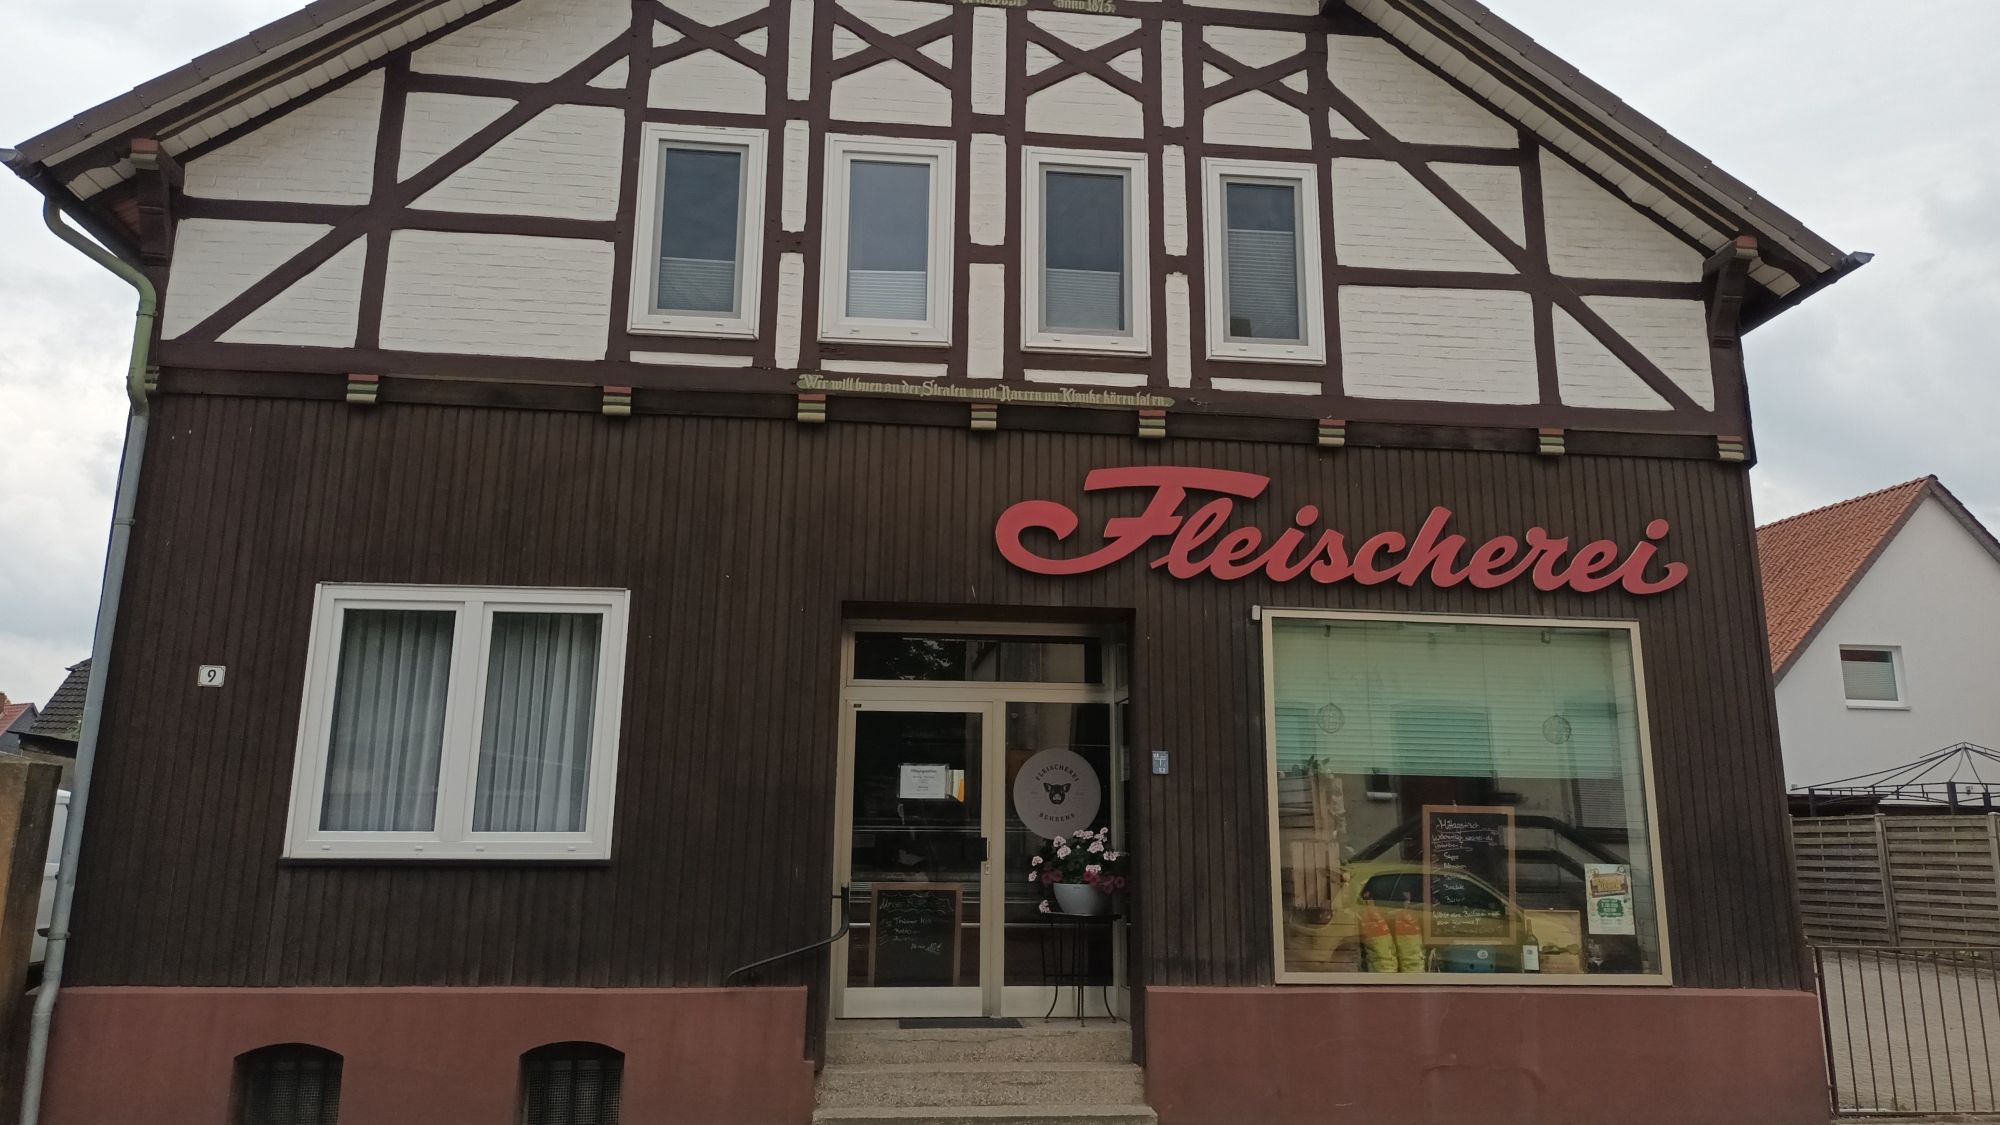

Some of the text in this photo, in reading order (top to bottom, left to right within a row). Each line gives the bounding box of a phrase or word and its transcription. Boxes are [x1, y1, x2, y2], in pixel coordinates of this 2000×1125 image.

[799, 374, 828, 389] Wer
[831, 377, 854, 391] will
[884, 382, 900, 393] an
[901, 380, 919, 395] der
[995, 465, 1689, 594] Fleischerei
[207, 669, 217, 683] 9
[1035, 763, 1080, 782] FLEISCHEREI
